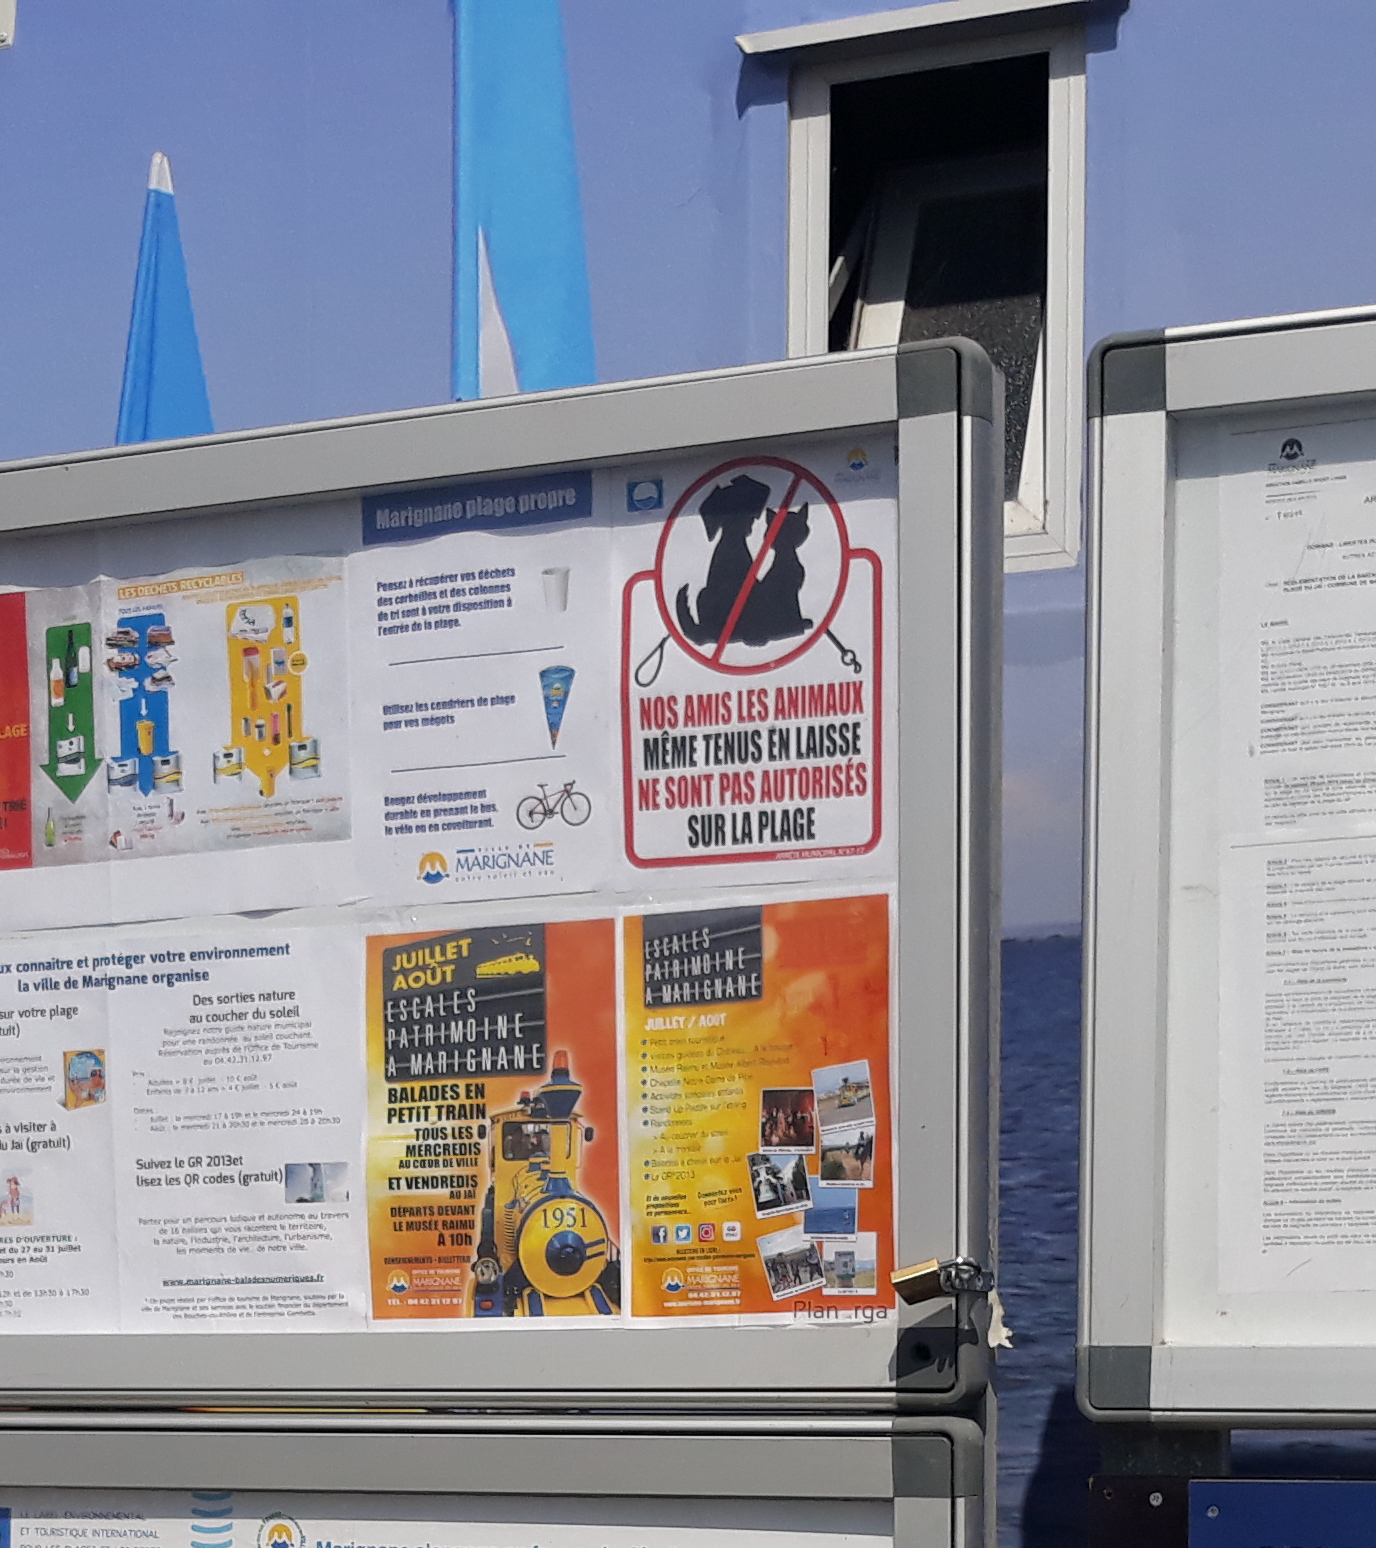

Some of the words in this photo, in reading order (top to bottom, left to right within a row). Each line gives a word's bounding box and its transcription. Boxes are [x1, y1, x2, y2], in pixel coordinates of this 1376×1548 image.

[376, 502, 462, 529] Marignane
[466, 496, 515, 519] plage
[519, 489, 576, 514] propre
[640, 695, 678, 730] NOS
[684, 692, 731, 727] AMIS
[738, 688, 768, 723] LES
[774, 681, 863, 720] ANIMAUX
[643, 731, 697, 770] MÊME
[703, 730, 762, 766] TENUS
[768, 726, 790, 761] EN
[796, 722, 860, 759] LAISSE
[638, 778, 660, 811] NE
[665, 774, 714, 809] SONT
[719, 771, 755, 805] PAS
[762, 758, 867, 802] AUTORISÉS
[688, 814, 725, 848] SUR
[732, 812, 752, 845] LA
[758, 807, 815, 843] PLAGE
[77, 956, 89, 968] et
[93, 954, 145, 971] protéger
[150, 951, 185, 963] votre
[190, 944, 290, 961] environnement
[392, 939, 472, 972] JUILLET
[18, 979, 29, 992] la
[33, 978, 60, 991] ville
[64, 976, 78, 989] de
[83, 974, 147, 990] Marignane
[152, 969, 209, 987] organise
[392, 960, 456, 991] AOÛT
[387, 989, 476, 1023] ESCALES
[388, 1013, 524, 1051] PATRIMOINE
[410, 1043, 542, 1076] MARIGNANE
[388, 1084, 460, 1104] BALADES
[465, 1083, 485, 1099] EN
[388, 1106, 431, 1124] PETIT
[435, 1103, 486, 1121] TRAIN
[542, 1207, 587, 1228] 1951
[793, 1300, 888, 1323] Planrga
